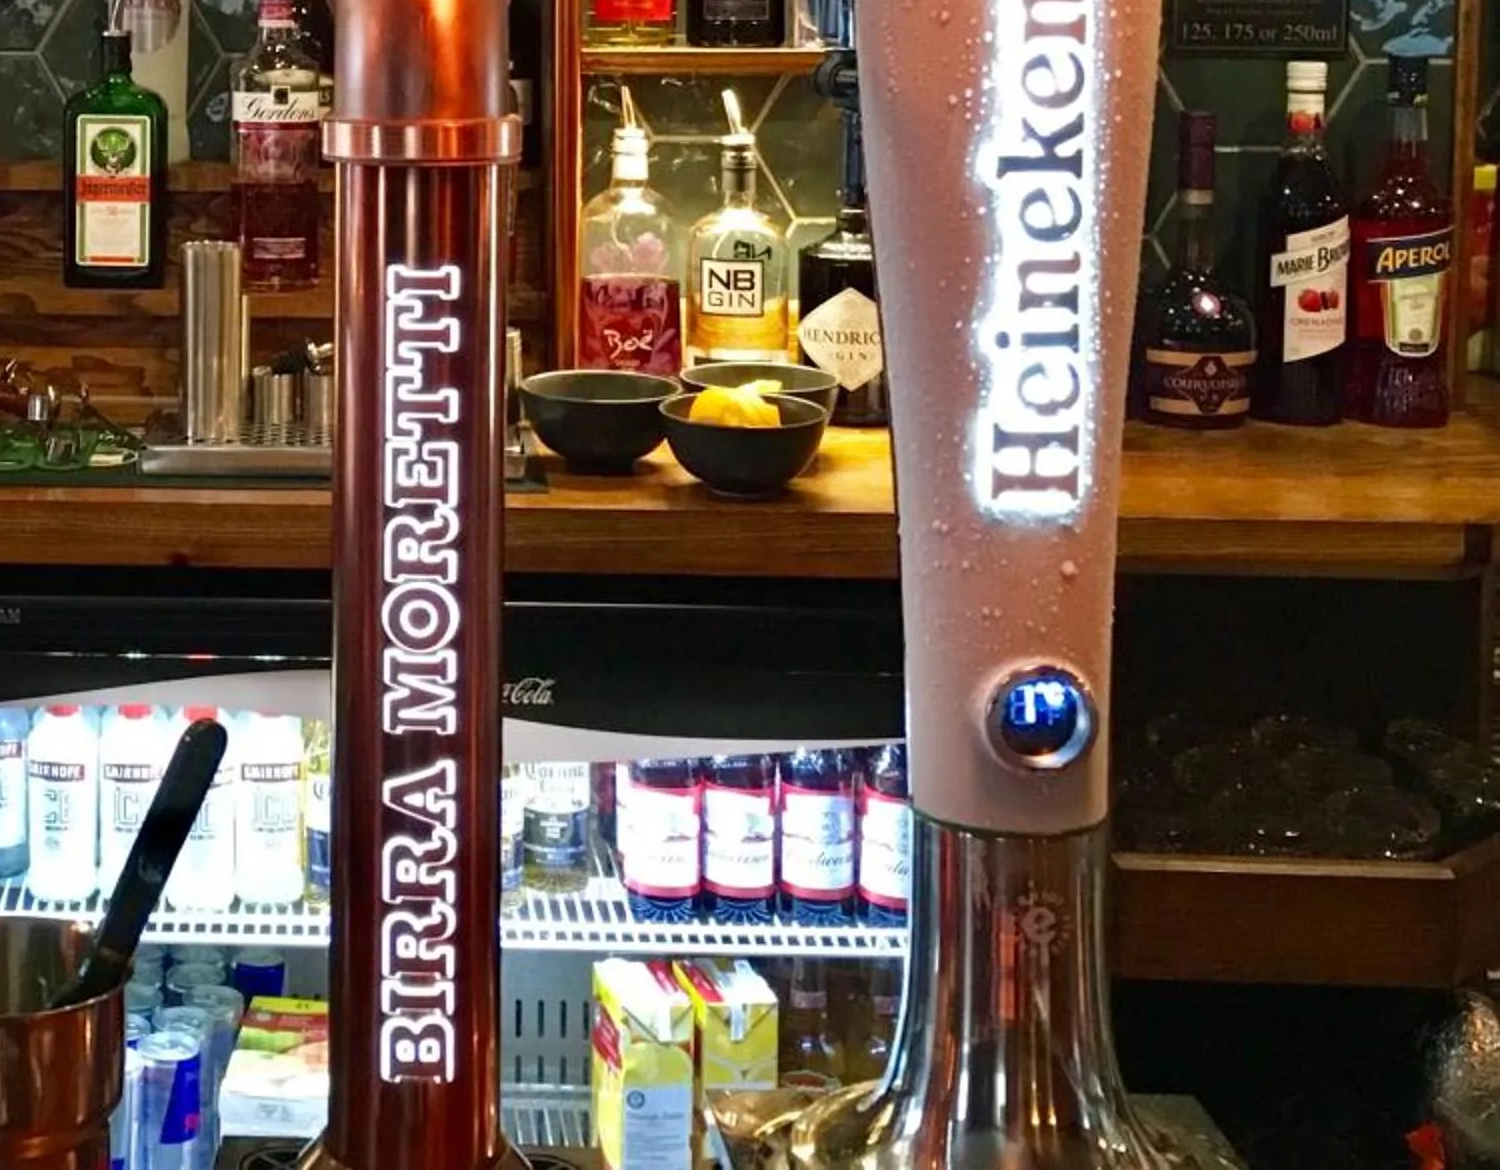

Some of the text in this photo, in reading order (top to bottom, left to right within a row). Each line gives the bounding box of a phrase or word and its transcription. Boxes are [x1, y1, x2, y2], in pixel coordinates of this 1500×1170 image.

[707, 268, 756, 291] NB
[707, 293, 756, 309] GIN
[802, 329, 882, 345] HENDRIC
[380, 263, 461, 1084] BIRRA MORETTI
